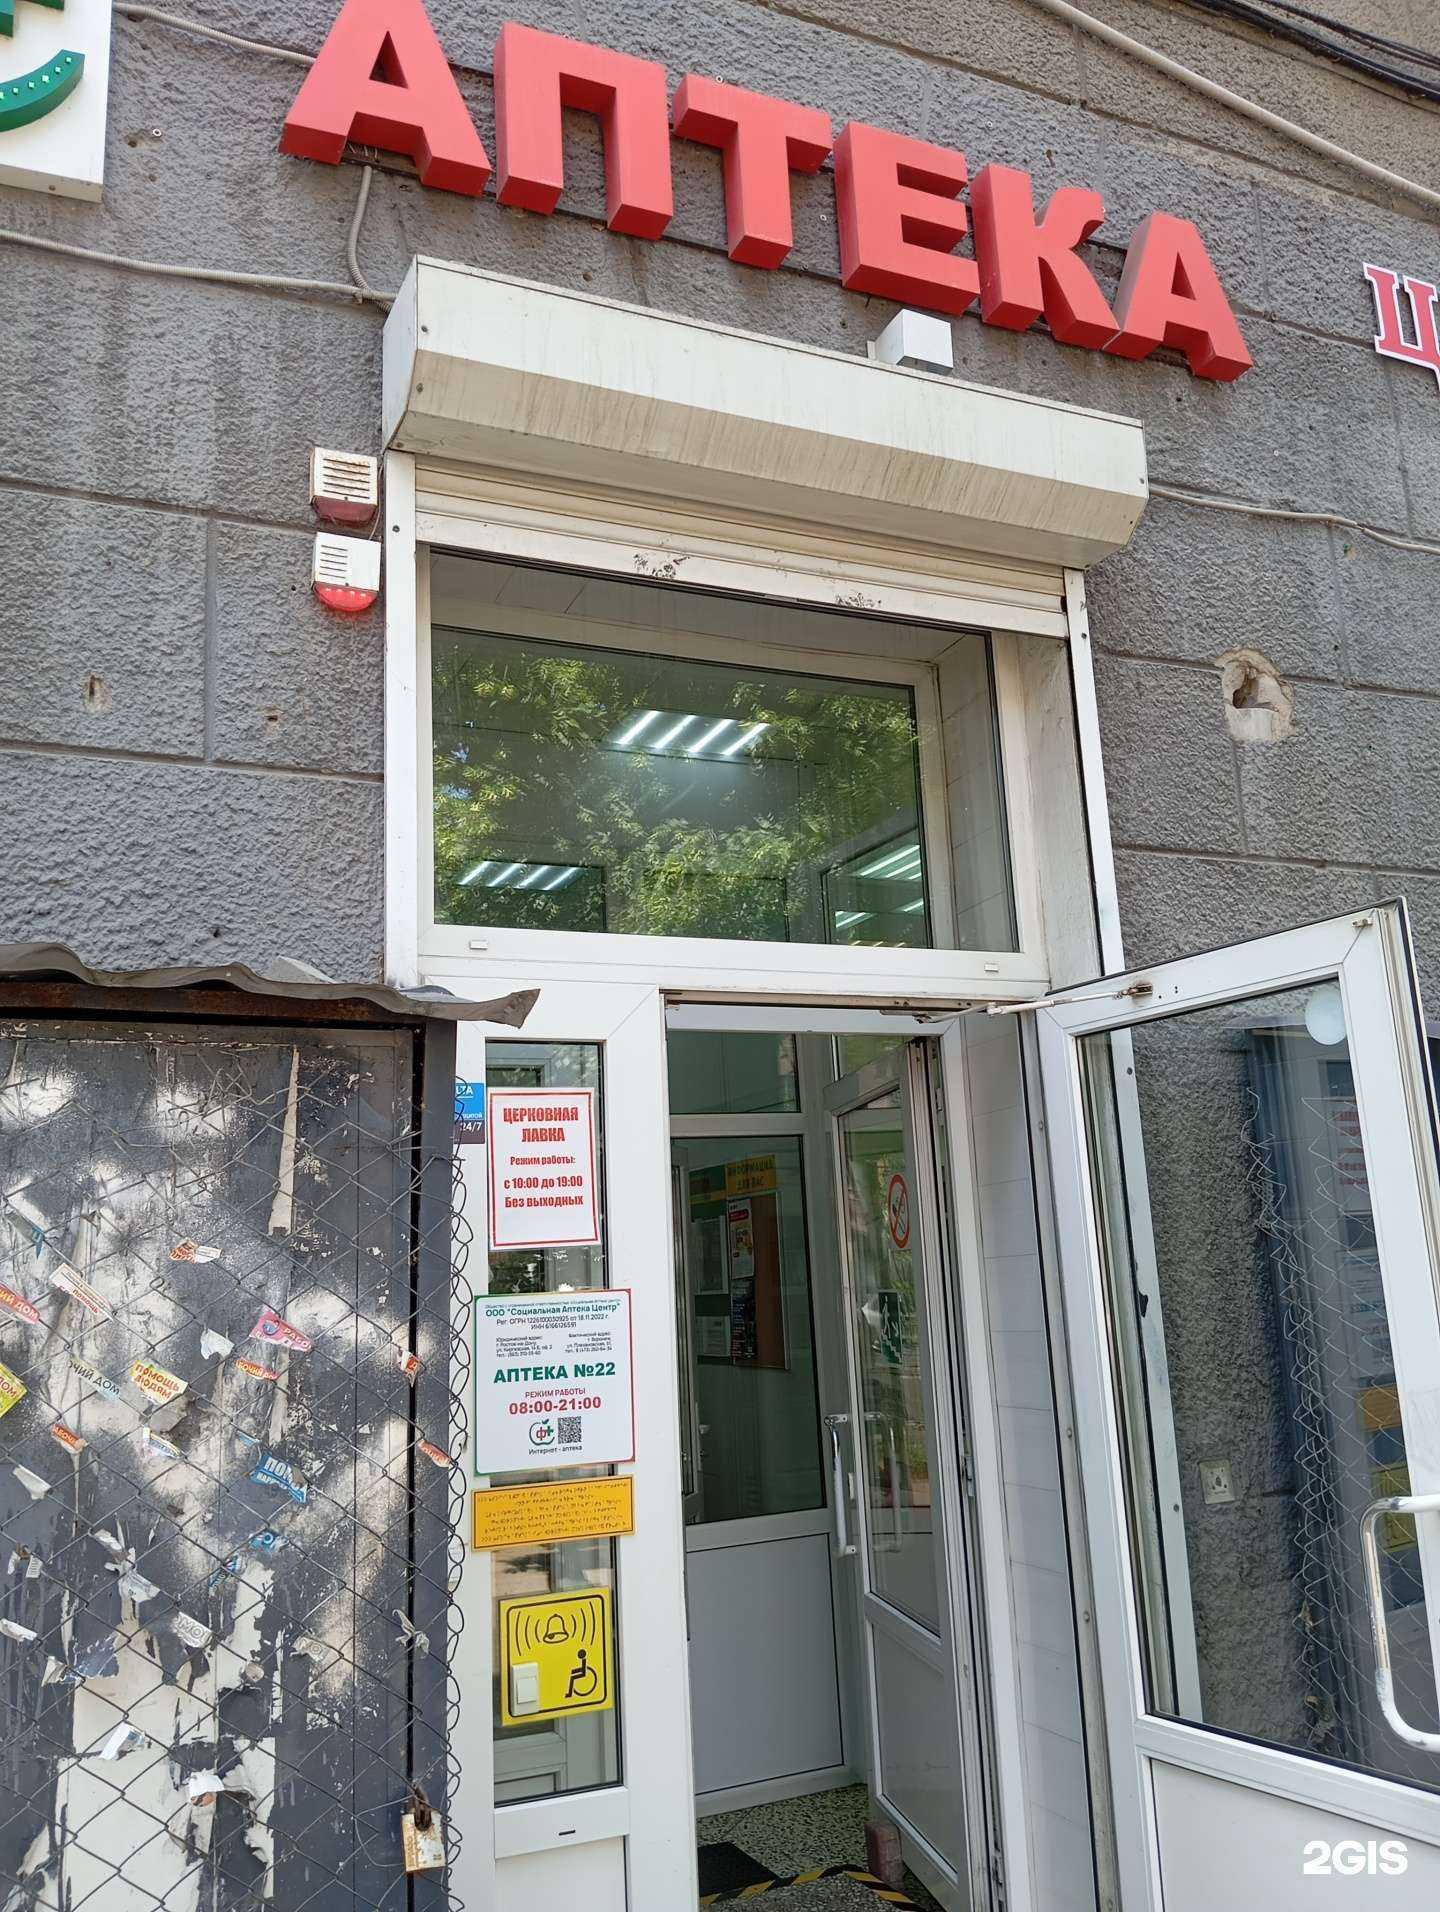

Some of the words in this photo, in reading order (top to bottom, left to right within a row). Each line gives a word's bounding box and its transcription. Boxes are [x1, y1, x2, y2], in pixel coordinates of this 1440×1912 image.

[279, 0, 1253, 382] АПТЕКА
[503, 1107, 579, 1124] ЦЕРКОВНАЯ
[521, 1127, 566, 1142] ЛАВКА
[510, 1156, 541, 1166] Режим
[541, 1155, 577, 1166] работы:
[511, 1177, 539, 1189] 10:00
[541, 1178, 554, 1190] до
[557, 1175, 583, 1187] 19:00
[505, 1196, 525, 1208] Без
[526, 1195, 584, 1207] выходных
[485, 1308, 505, 1317] ООО
[561, 1305, 591, 1313] Аптека
[68, 1360, 95, 1381] ЧИЙ
[134, 1362, 181, 1393] ПОМОЩЬ
[493, 1366, 568, 1383] АПТЕКА
[574, 1362, 616, 1378] №22
[525, 1389, 554, 1399] РЕЖИМ
[554, 1387, 586, 1397] РАБОТЫ
[509, 1396, 602, 1415] 08:00-21:00
